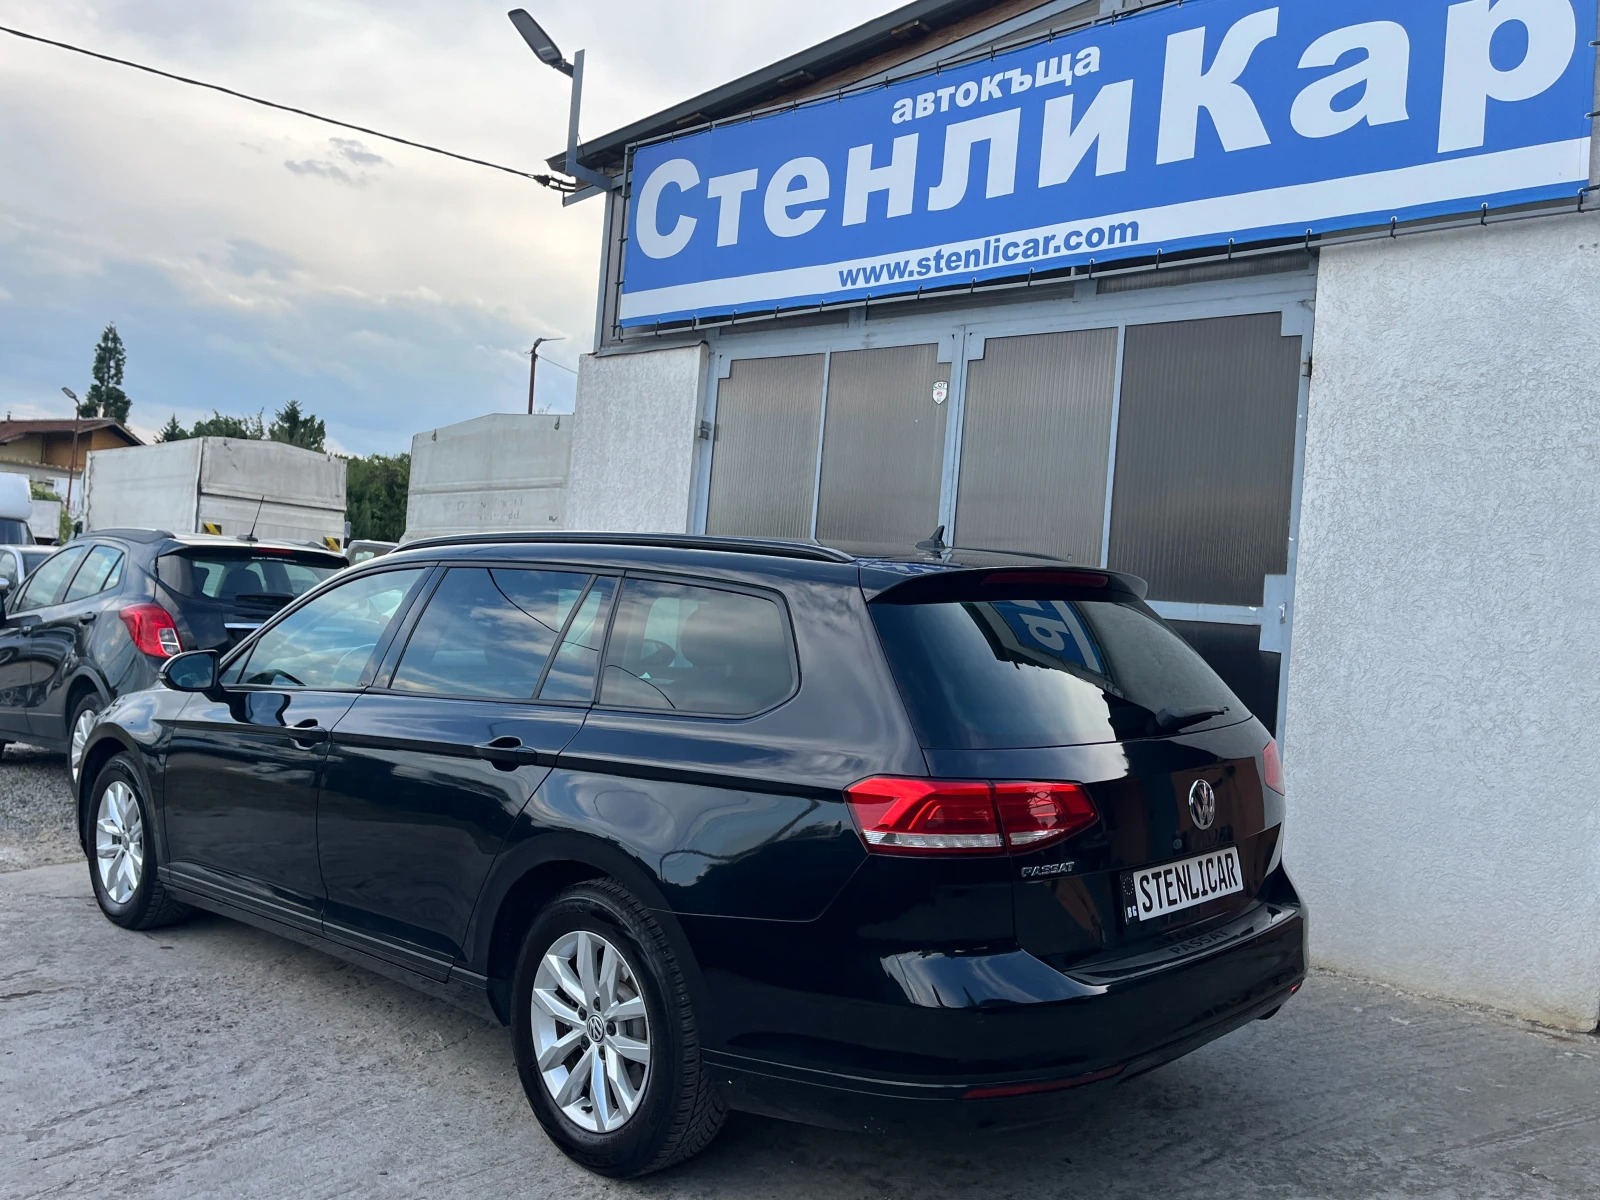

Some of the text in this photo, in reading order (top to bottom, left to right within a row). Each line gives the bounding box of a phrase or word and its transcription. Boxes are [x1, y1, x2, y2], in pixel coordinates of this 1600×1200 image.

[891, 46, 1101, 124] автокъща
[636, 0, 1576, 260] СтенлиКар
[838, 220, 1139, 288] www.stenlicar.com
[1021, 861, 1075, 877] PASSAT
[1139, 852, 1238, 913] STENLICAR
[1127, 905, 1138, 918] BG
[1168, 929, 1229, 955] PASSAT
